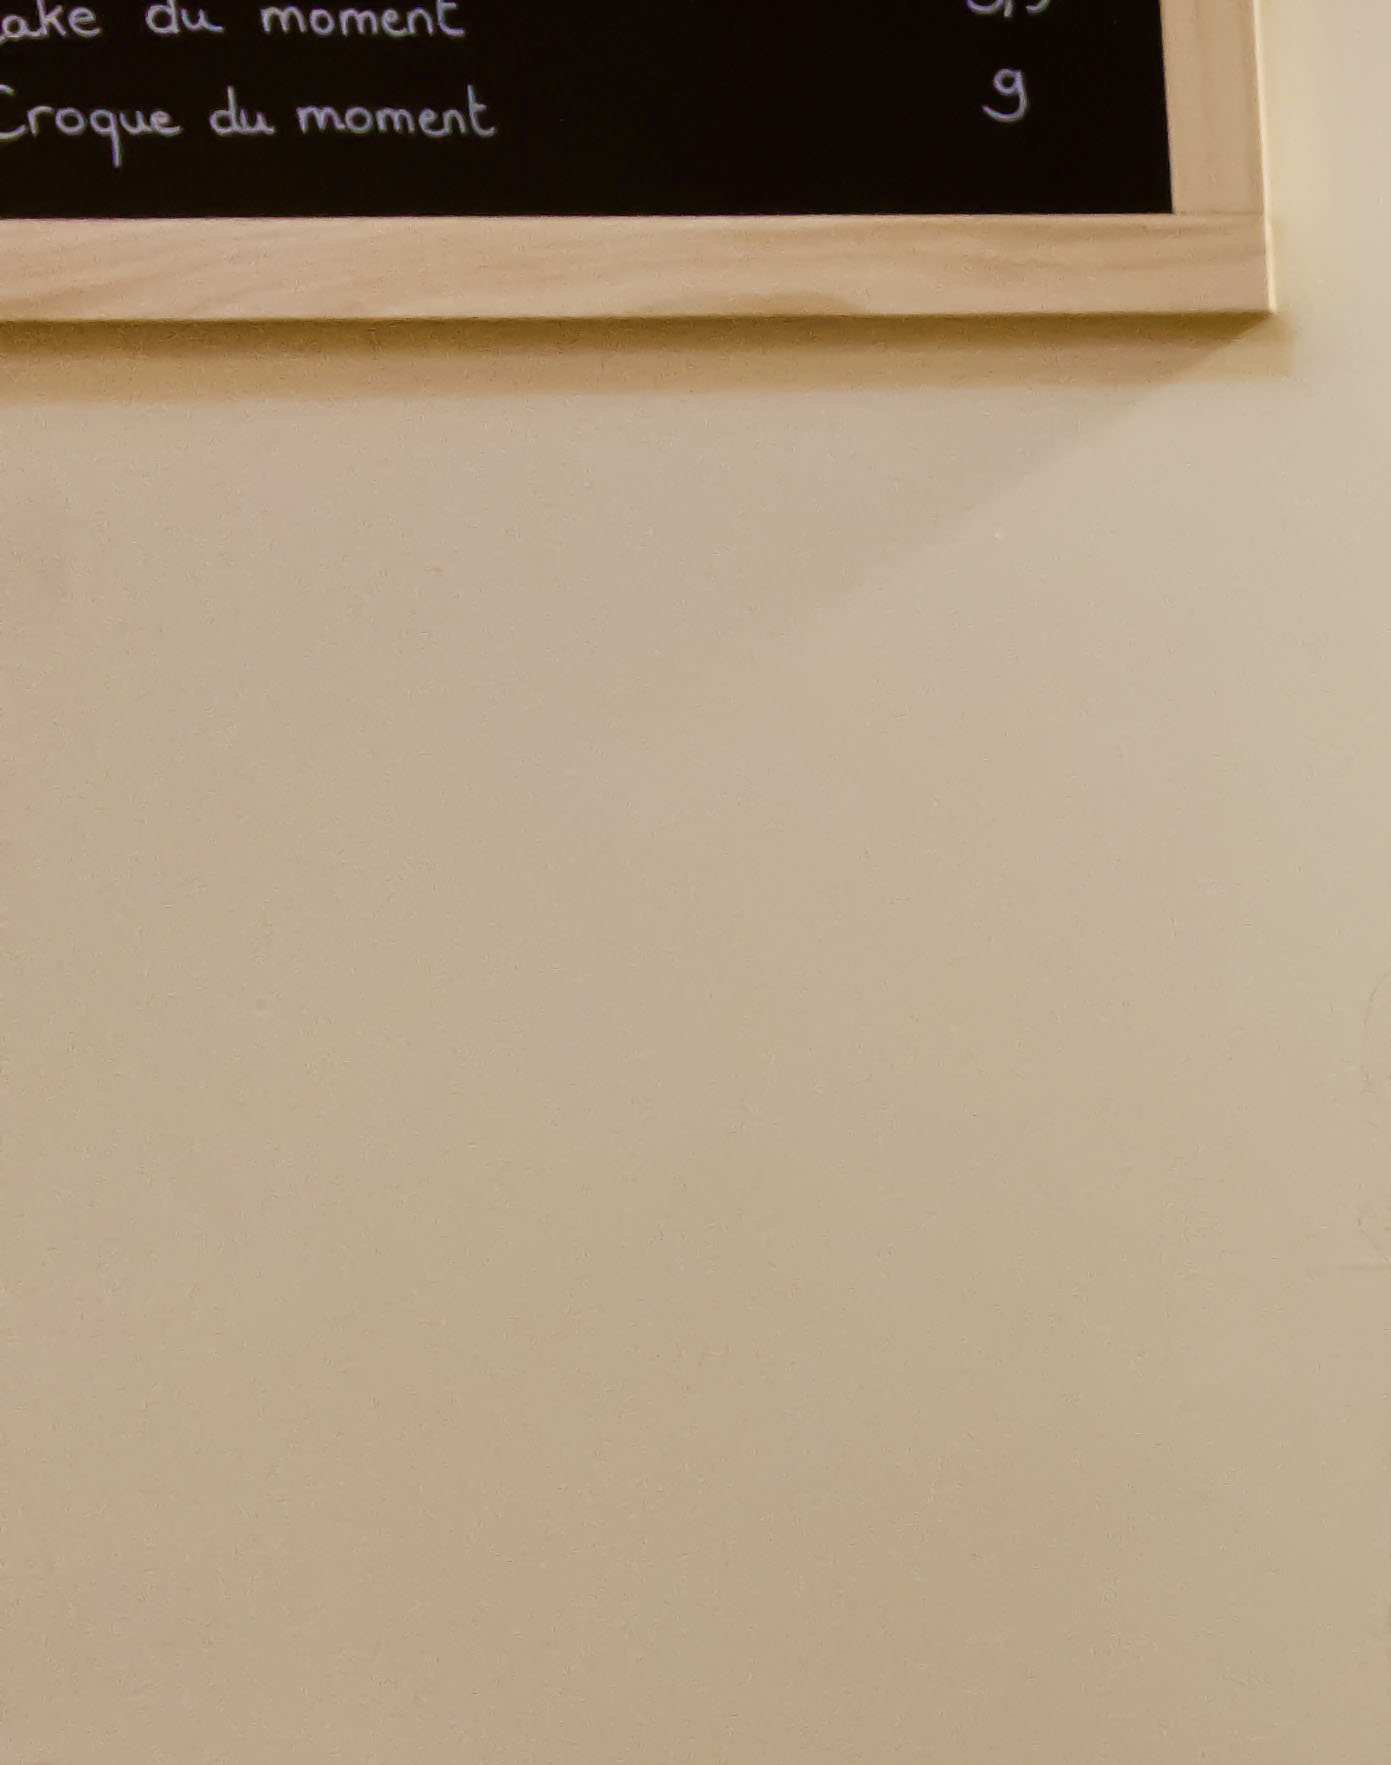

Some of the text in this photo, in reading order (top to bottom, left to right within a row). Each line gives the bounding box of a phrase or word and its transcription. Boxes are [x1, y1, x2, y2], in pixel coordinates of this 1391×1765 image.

[0, 0, 465, 42] ake du moment
[210, 86, 276, 136] du
[299, 85, 496, 136] moment
